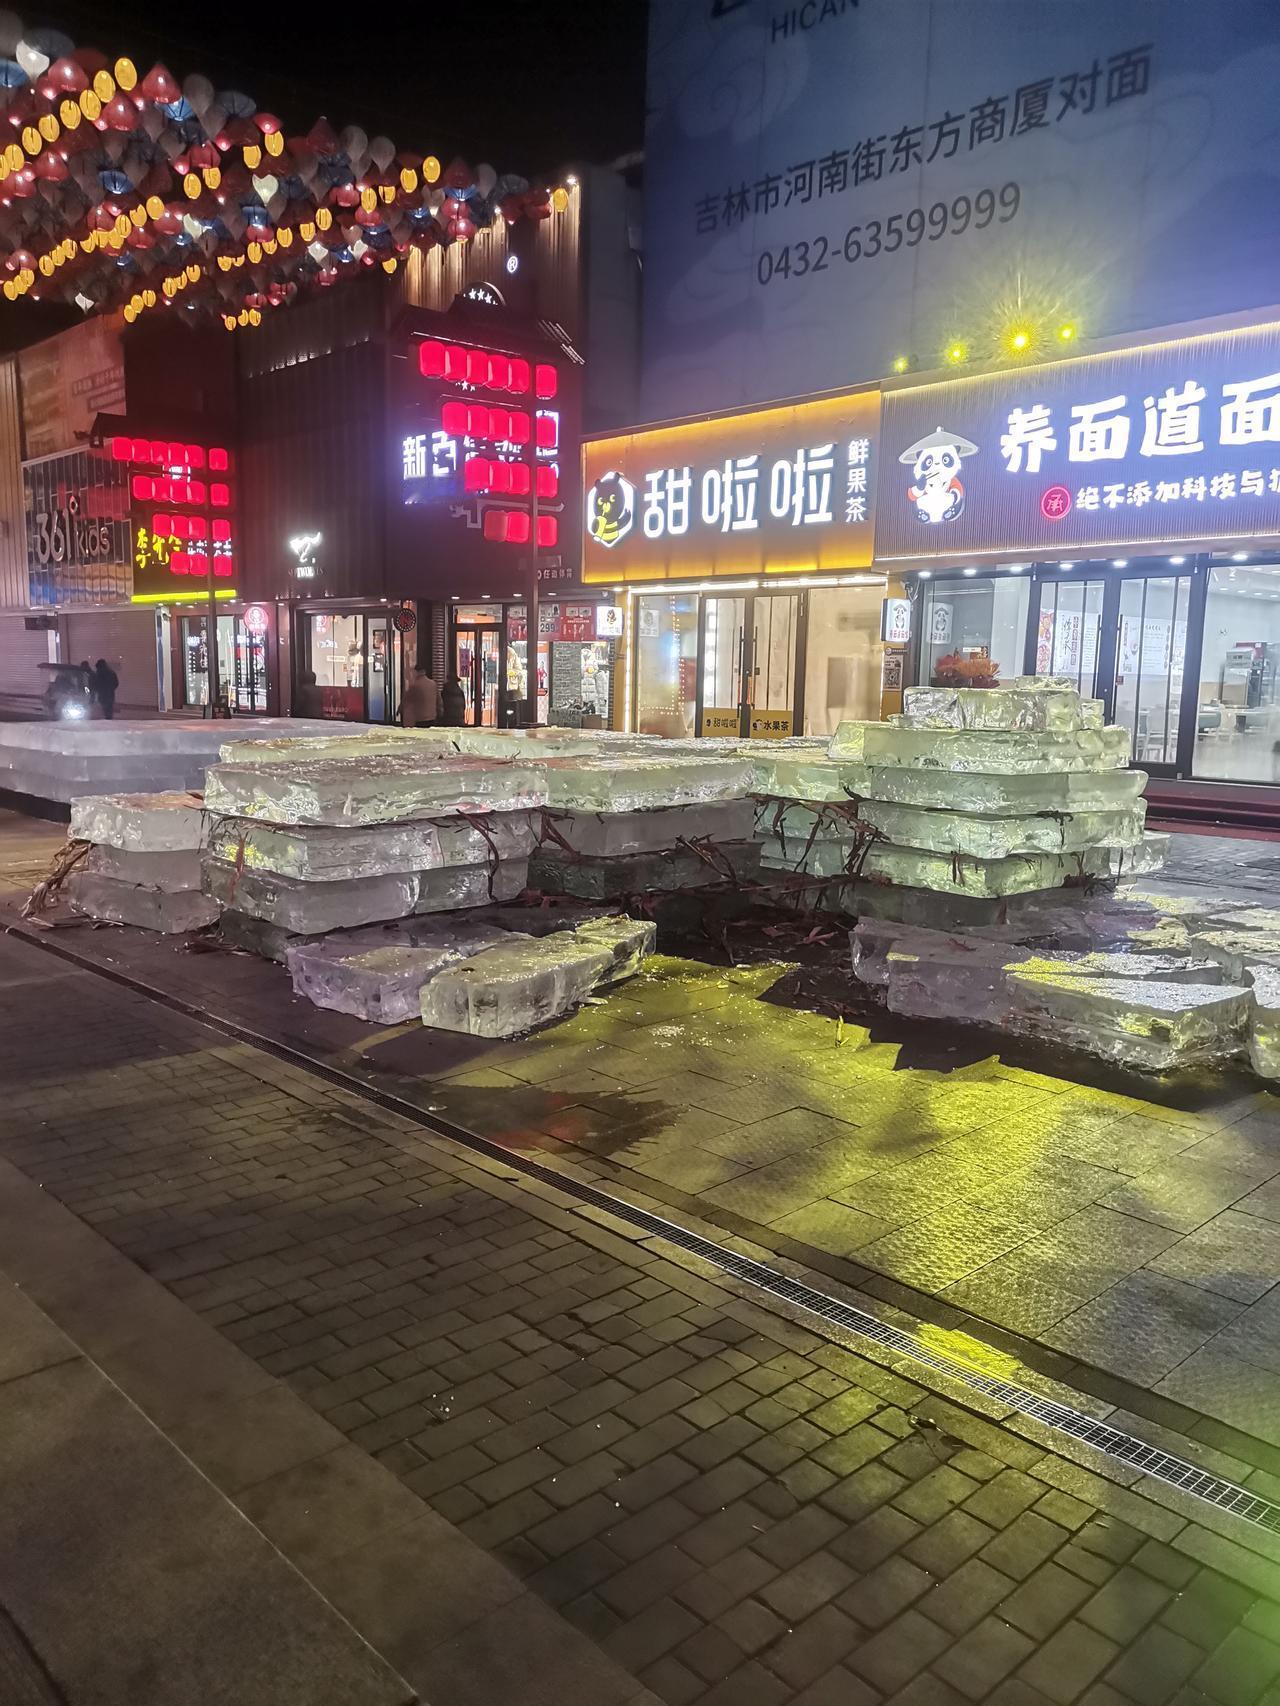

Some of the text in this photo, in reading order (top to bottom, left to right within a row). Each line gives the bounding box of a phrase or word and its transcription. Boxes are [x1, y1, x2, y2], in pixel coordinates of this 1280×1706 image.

[693, 43, 1155, 235] 吉林市河南街东方商厦对面
[756, 181, 1022, 286] 0432-63599999
[1000, 371, 1280, 473] 养面道面
[643, 443, 837, 539] 甜啦啦
[845, 438, 870, 523] 鲜果茶
[74, 519, 111, 557] kids
[763, 720, 790, 732] 水果茶
